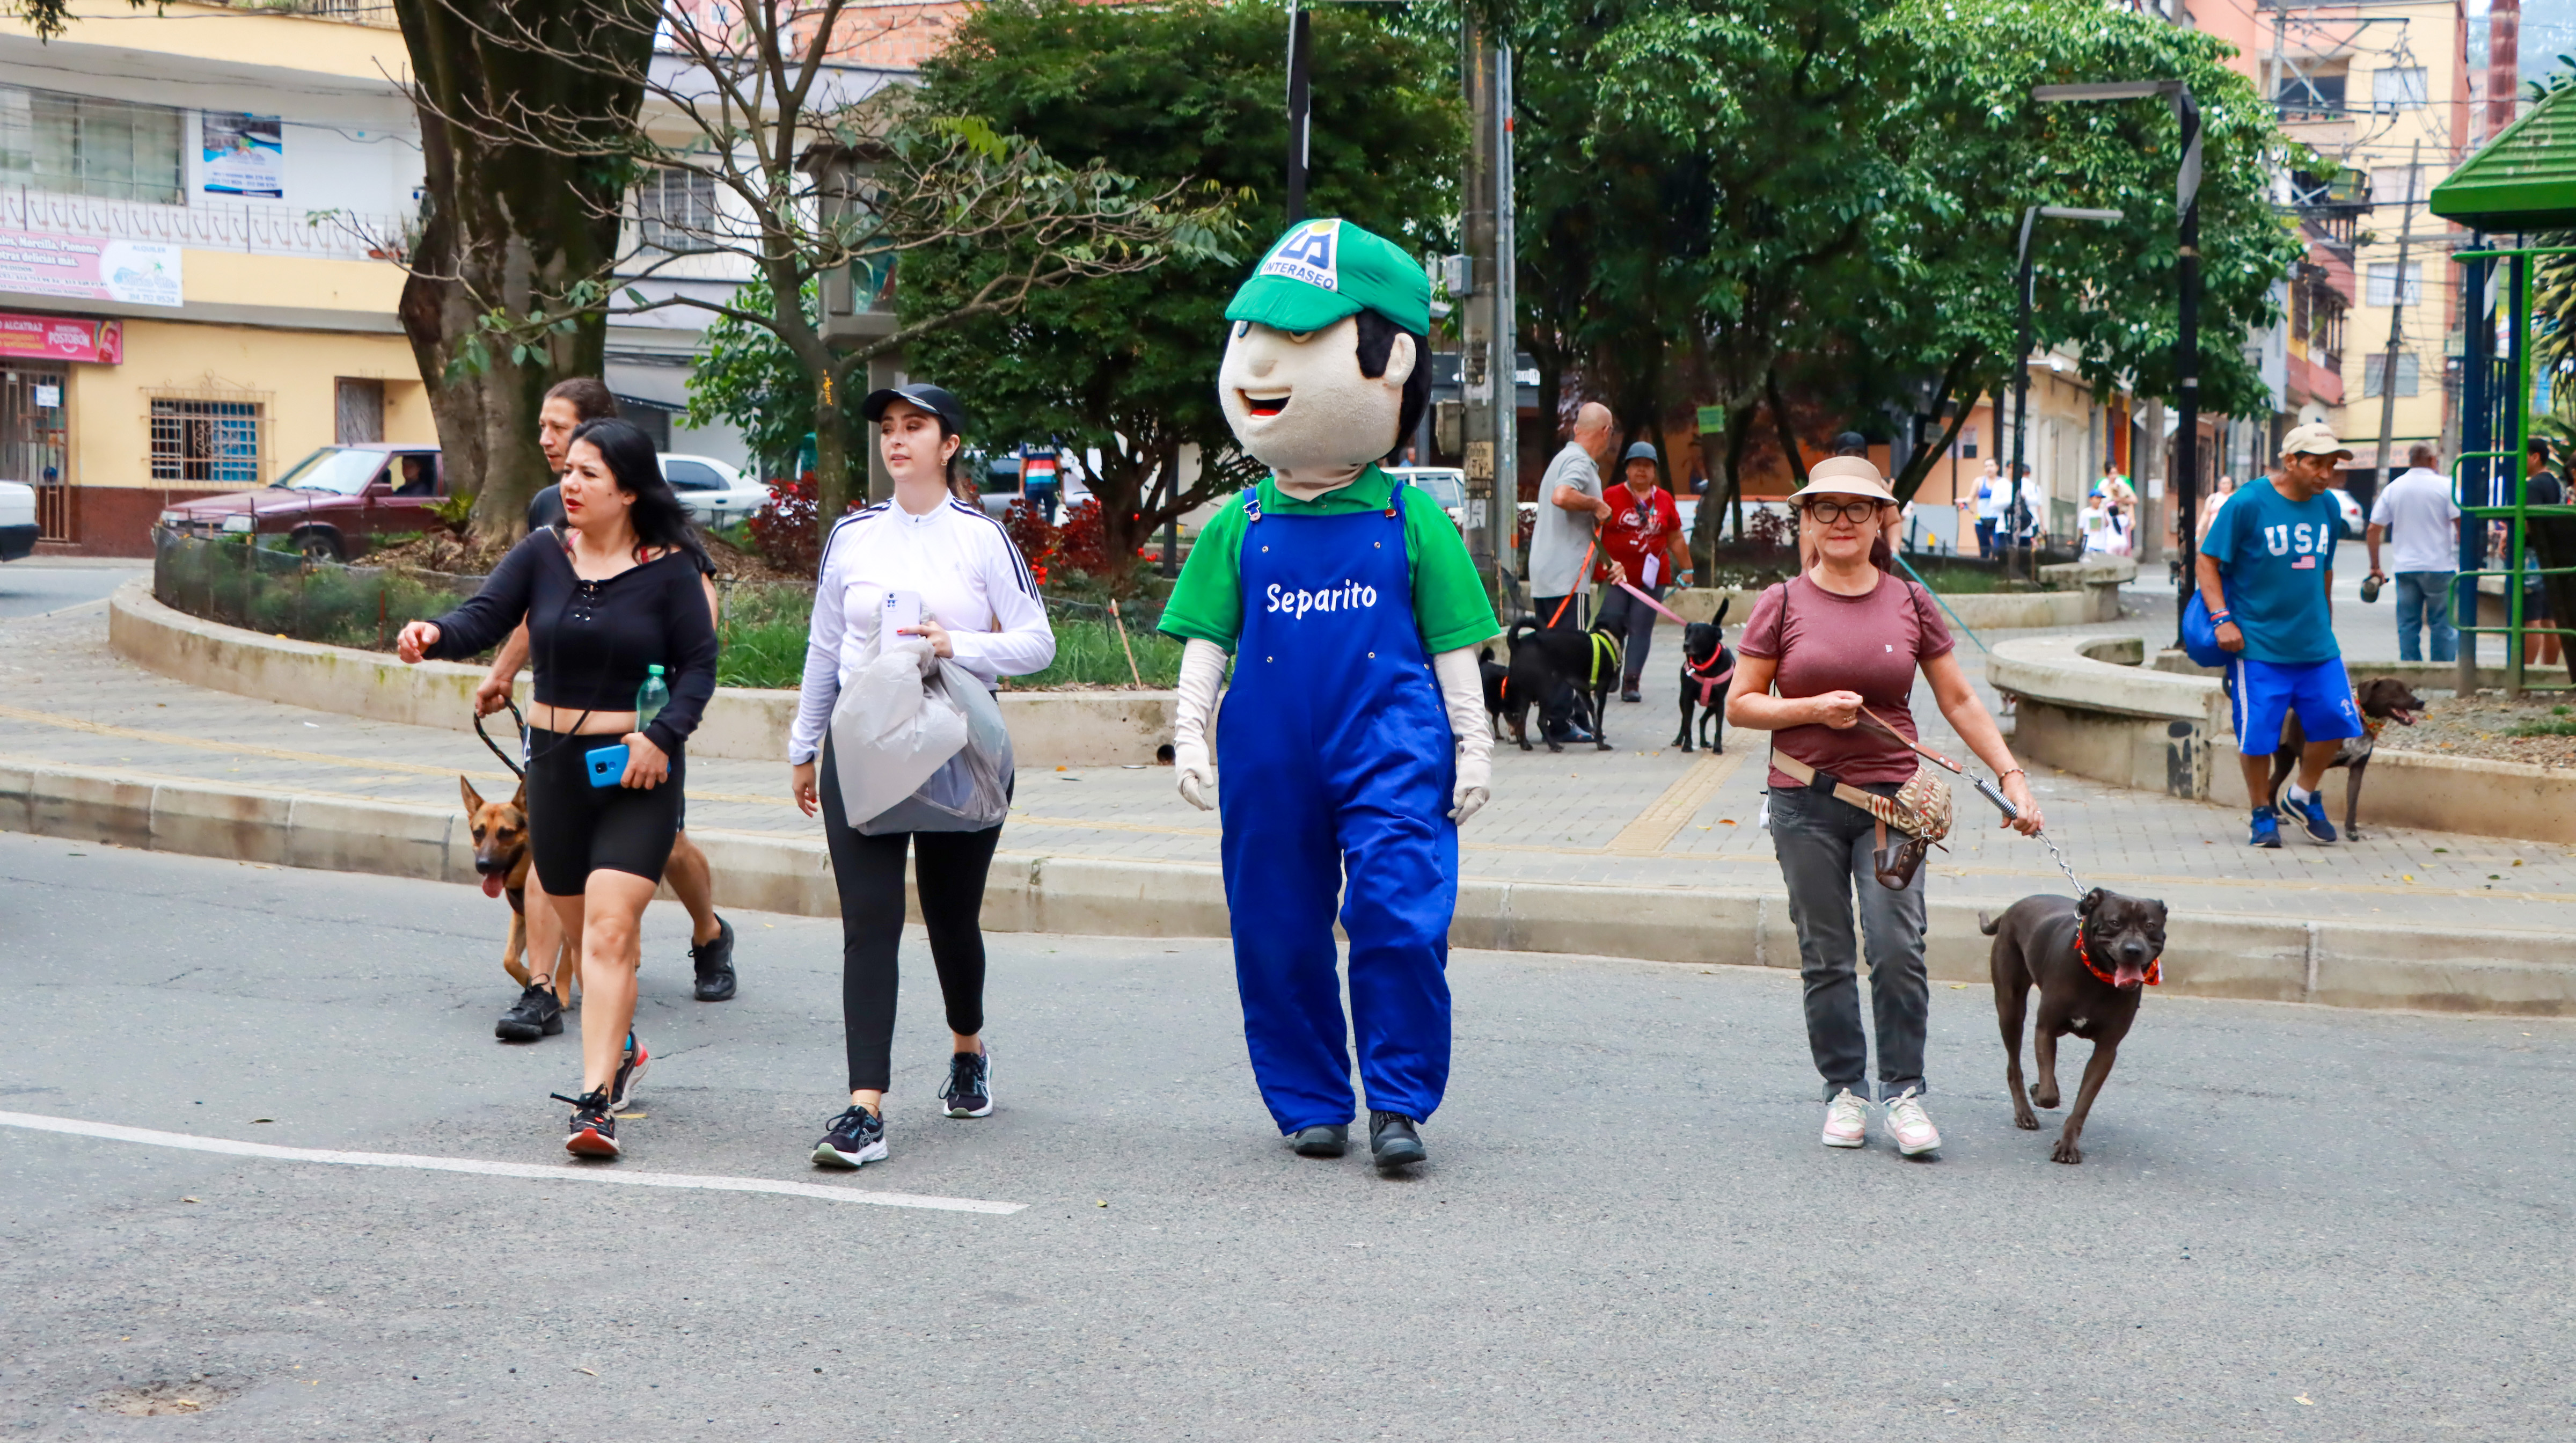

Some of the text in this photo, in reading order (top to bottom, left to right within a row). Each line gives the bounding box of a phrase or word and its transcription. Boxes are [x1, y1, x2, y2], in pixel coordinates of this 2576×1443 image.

[21, 252, 56, 265] delicias
[133, 245, 166, 253] ALQUILER
[1263, 261, 1335, 290] INTERASEO
[4, 320, 43, 332] ALCATRAZ
[2264, 522, 2328, 556] USA
[1267, 578, 1377, 620] Separito
